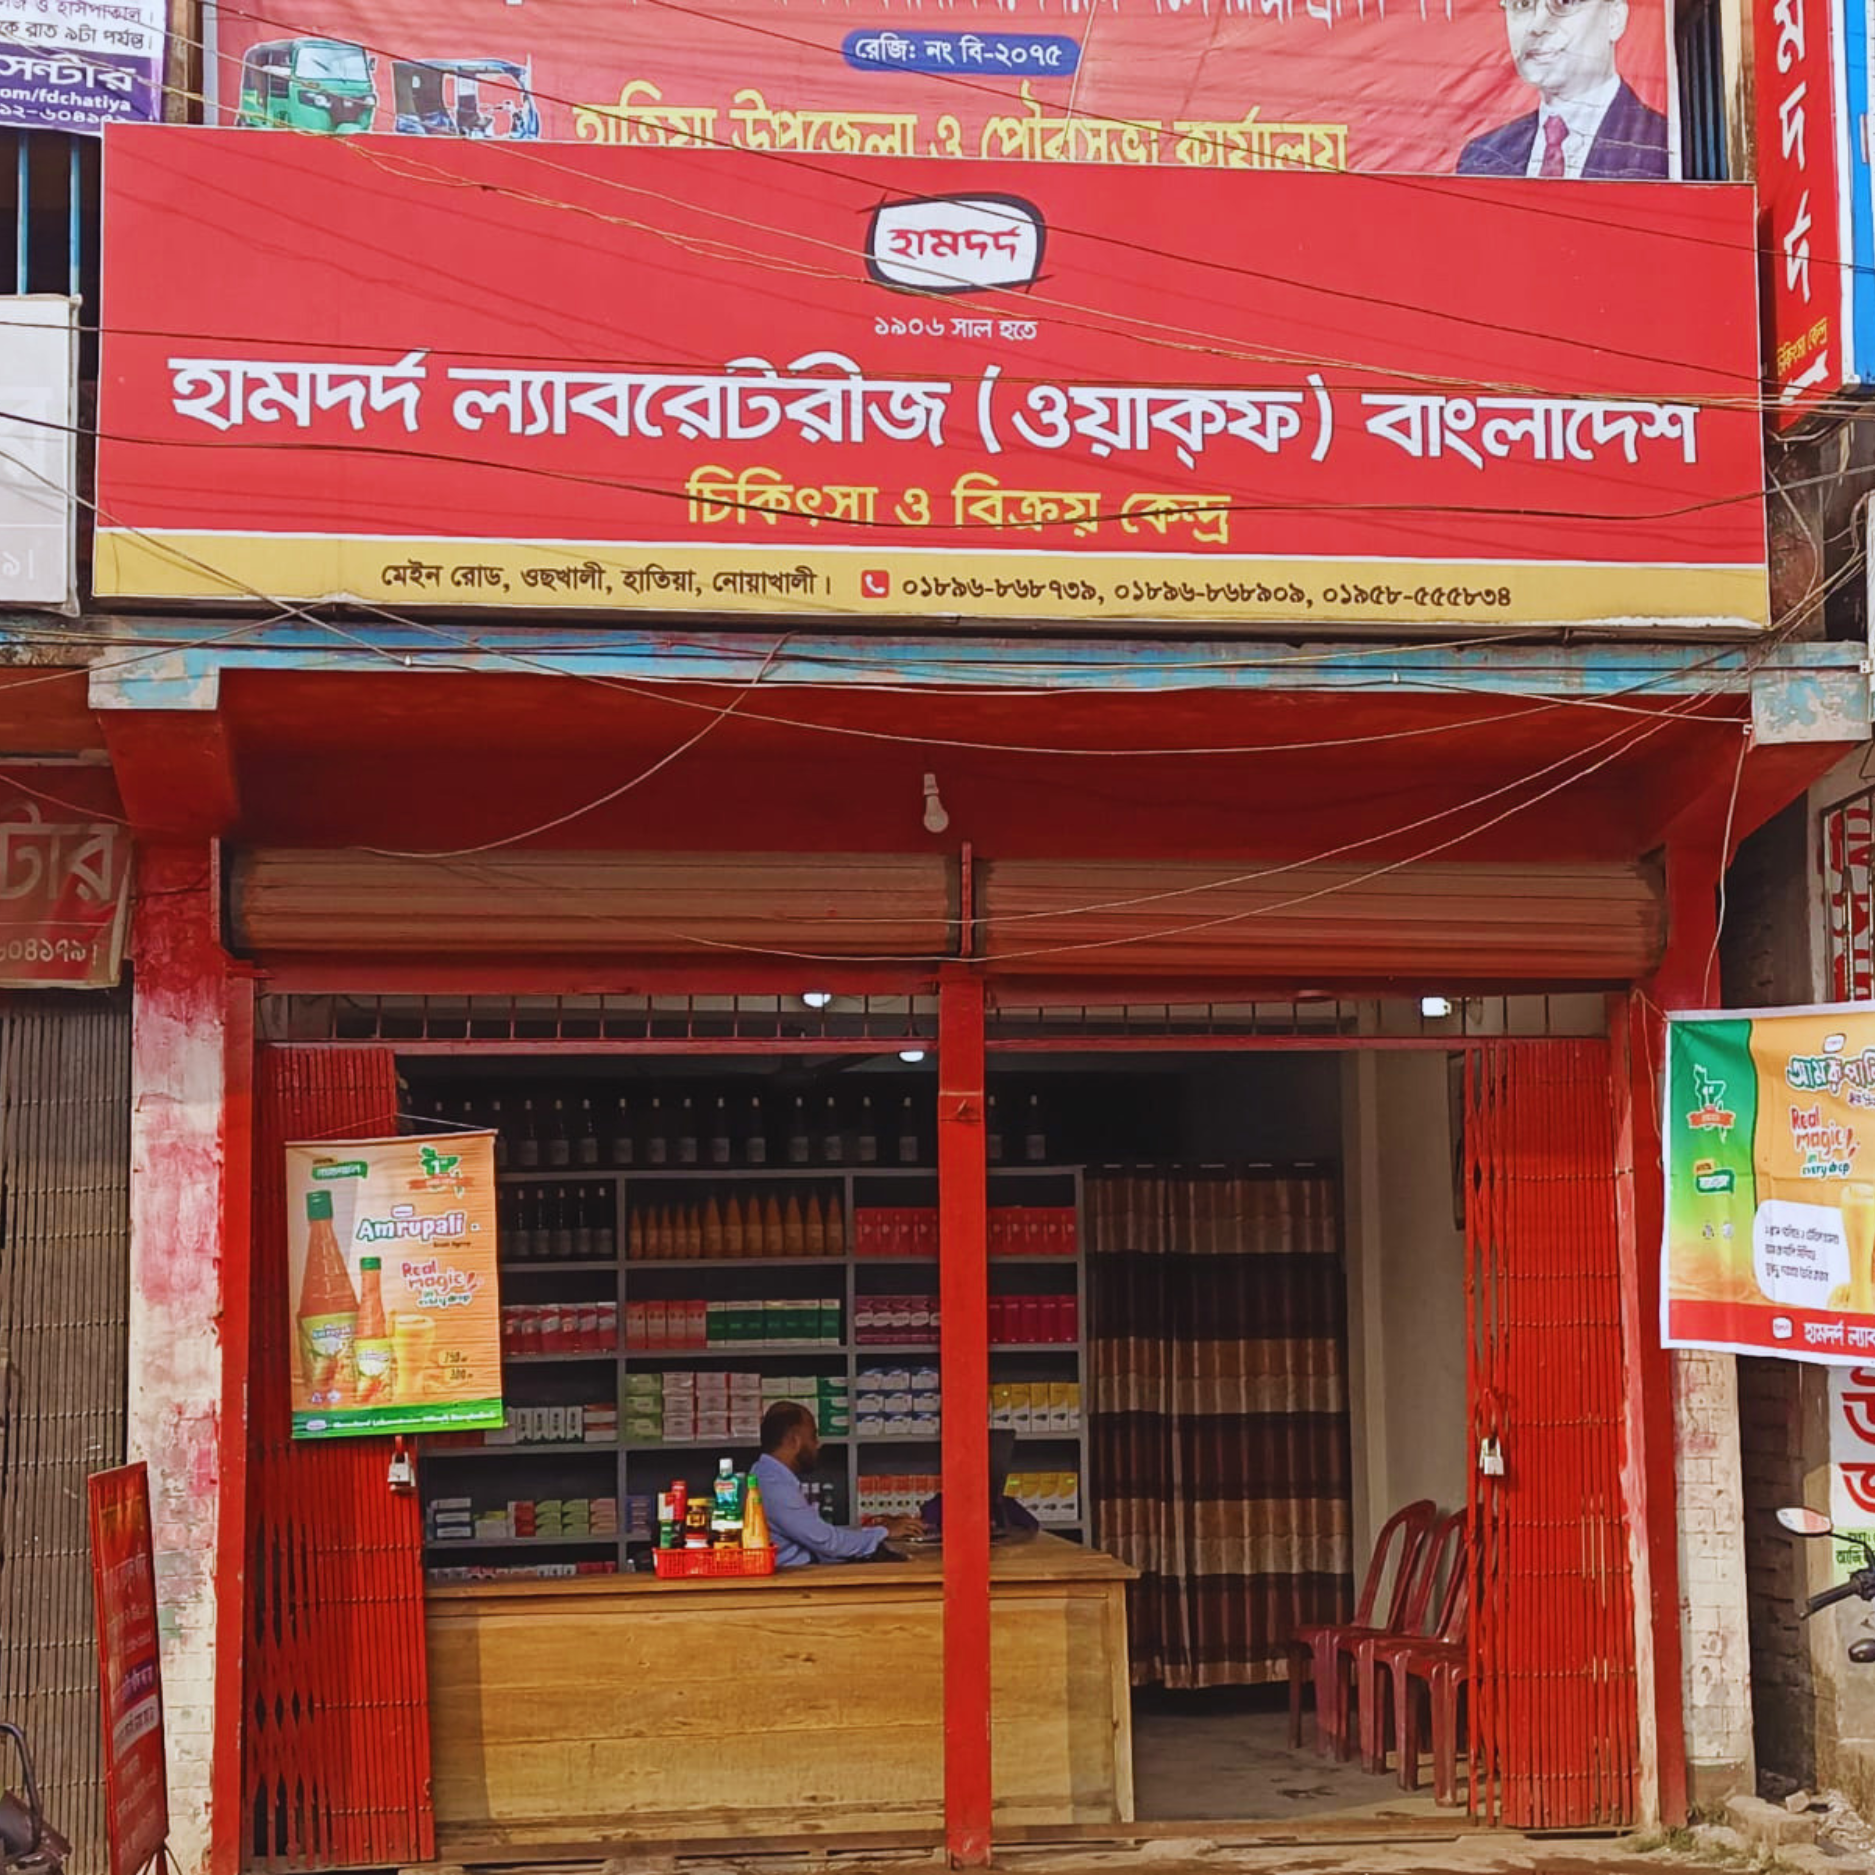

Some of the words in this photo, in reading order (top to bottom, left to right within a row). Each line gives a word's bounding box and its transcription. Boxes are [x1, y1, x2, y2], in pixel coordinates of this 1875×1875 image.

[26, 21, 58, 38] রাত
[65, 24, 98, 43] ৯টা
[925, 40, 954, 65] নং
[959, 34, 1063, 67] বি-২০৭৫
[0, 87, 132, 113] om/fdchatiya
[886, 225, 1021, 263] হামদর্দ
[874, 316, 945, 336] ১৯০৬
[950, 317, 992, 338] সাল
[999, 319, 1039, 341] হতে
[167, 348, 431, 432] হামদর্দ
[447, 350, 952, 447] ল্যাবরেটরীজ
[1361, 393, 1701, 471] বাংলাদেশ
[685, 464, 879, 527] চিকিৎসা
[895, 488, 931, 527] ও
[951, 472, 1101, 538] বিক্রয়
[1120, 493, 1232, 544] কেন্দ্র
[382, 559, 443, 588] মেইন
[451, 563, 511, 593] রোড,
[621, 563, 702, 597] হাতিয়া,
[1323, 584, 1512, 607] ০১৯৫৮-৫৫৫৮৩৪
[1791, 1105, 1820, 1130] Real
[357, 1212, 466, 1242] Amrupali
[401, 1260, 437, 1278] Real
